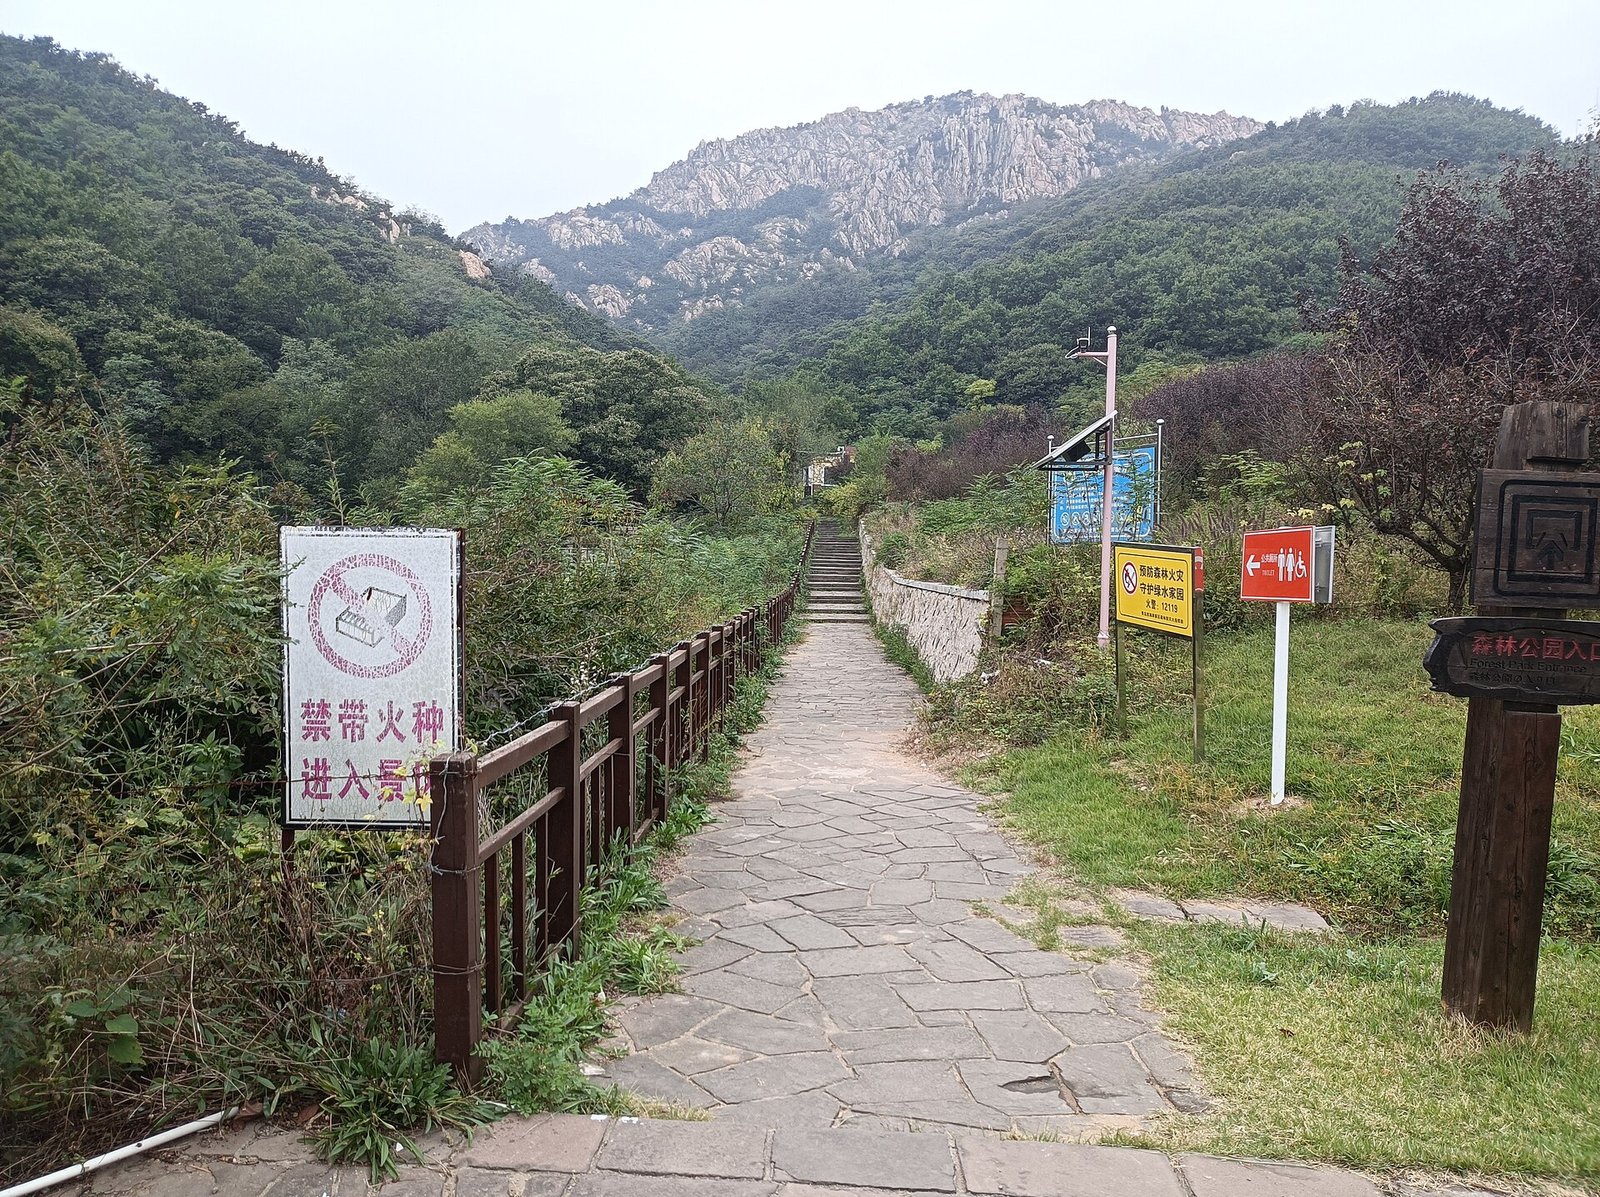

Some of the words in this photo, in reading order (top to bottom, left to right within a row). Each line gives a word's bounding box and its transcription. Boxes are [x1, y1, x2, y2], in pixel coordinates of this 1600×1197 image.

[1139, 564, 1184, 582] 预防森林火灾
[1139, 582, 1185, 601] 守护绿水家园
[1469, 657, 1506, 669] Forest
[1508, 659, 1534, 670] Park
[1537, 661, 1587, 673] Entrance
[300, 698, 444, 744] 禁带火种
